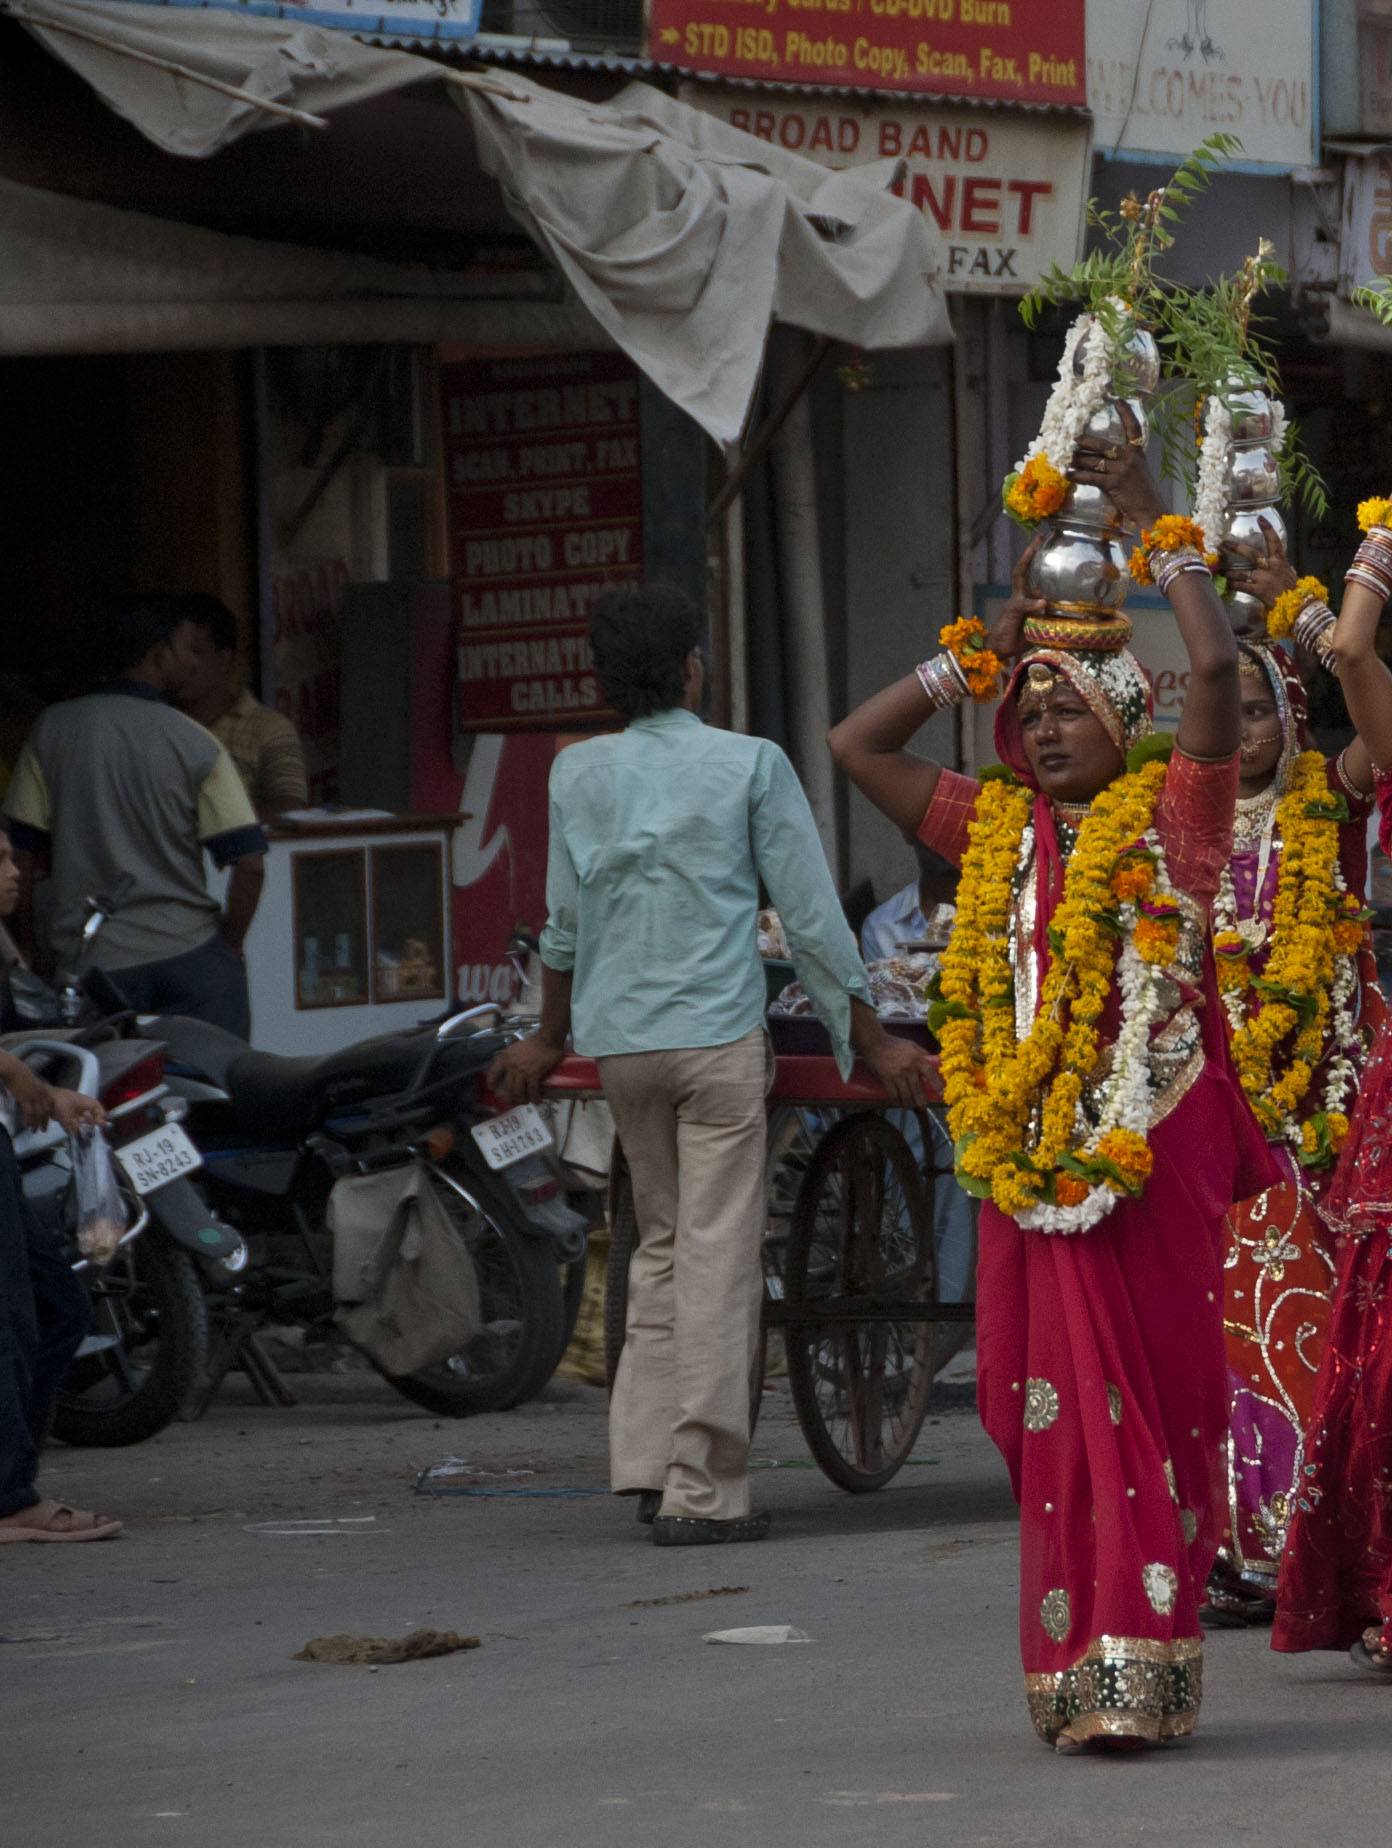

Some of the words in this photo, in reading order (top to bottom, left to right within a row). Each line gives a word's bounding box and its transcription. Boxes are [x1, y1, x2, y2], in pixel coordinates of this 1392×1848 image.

[960, 0, 1012, 27] Burn
[684, 21, 729, 57] STD
[735, 26, 778, 67] ISD,
[786, 31, 847, 68] Photo
[854, 37, 909, 80] Copy,
[916, 42, 973, 85] Scan,
[980, 48, 1023, 87] Fax,
[1028, 52, 1077, 87] Print
[1253, 76, 1307, 128] YOU
[729, 108, 861, 154] BROAD
[878, 119, 990, 162] BAND
[946, 246, 1018, 277] FAX
[595, 437, 638, 469] FAX
[502, 487, 591, 522] SKYPE
[466, 534, 553, 577] PHOTO
[563, 528, 632, 567] COPY
[463, 580, 638, 627] LAMINATI
[458, 638, 595, 681] INTERNATI
[511, 676, 597, 711] CALLS
